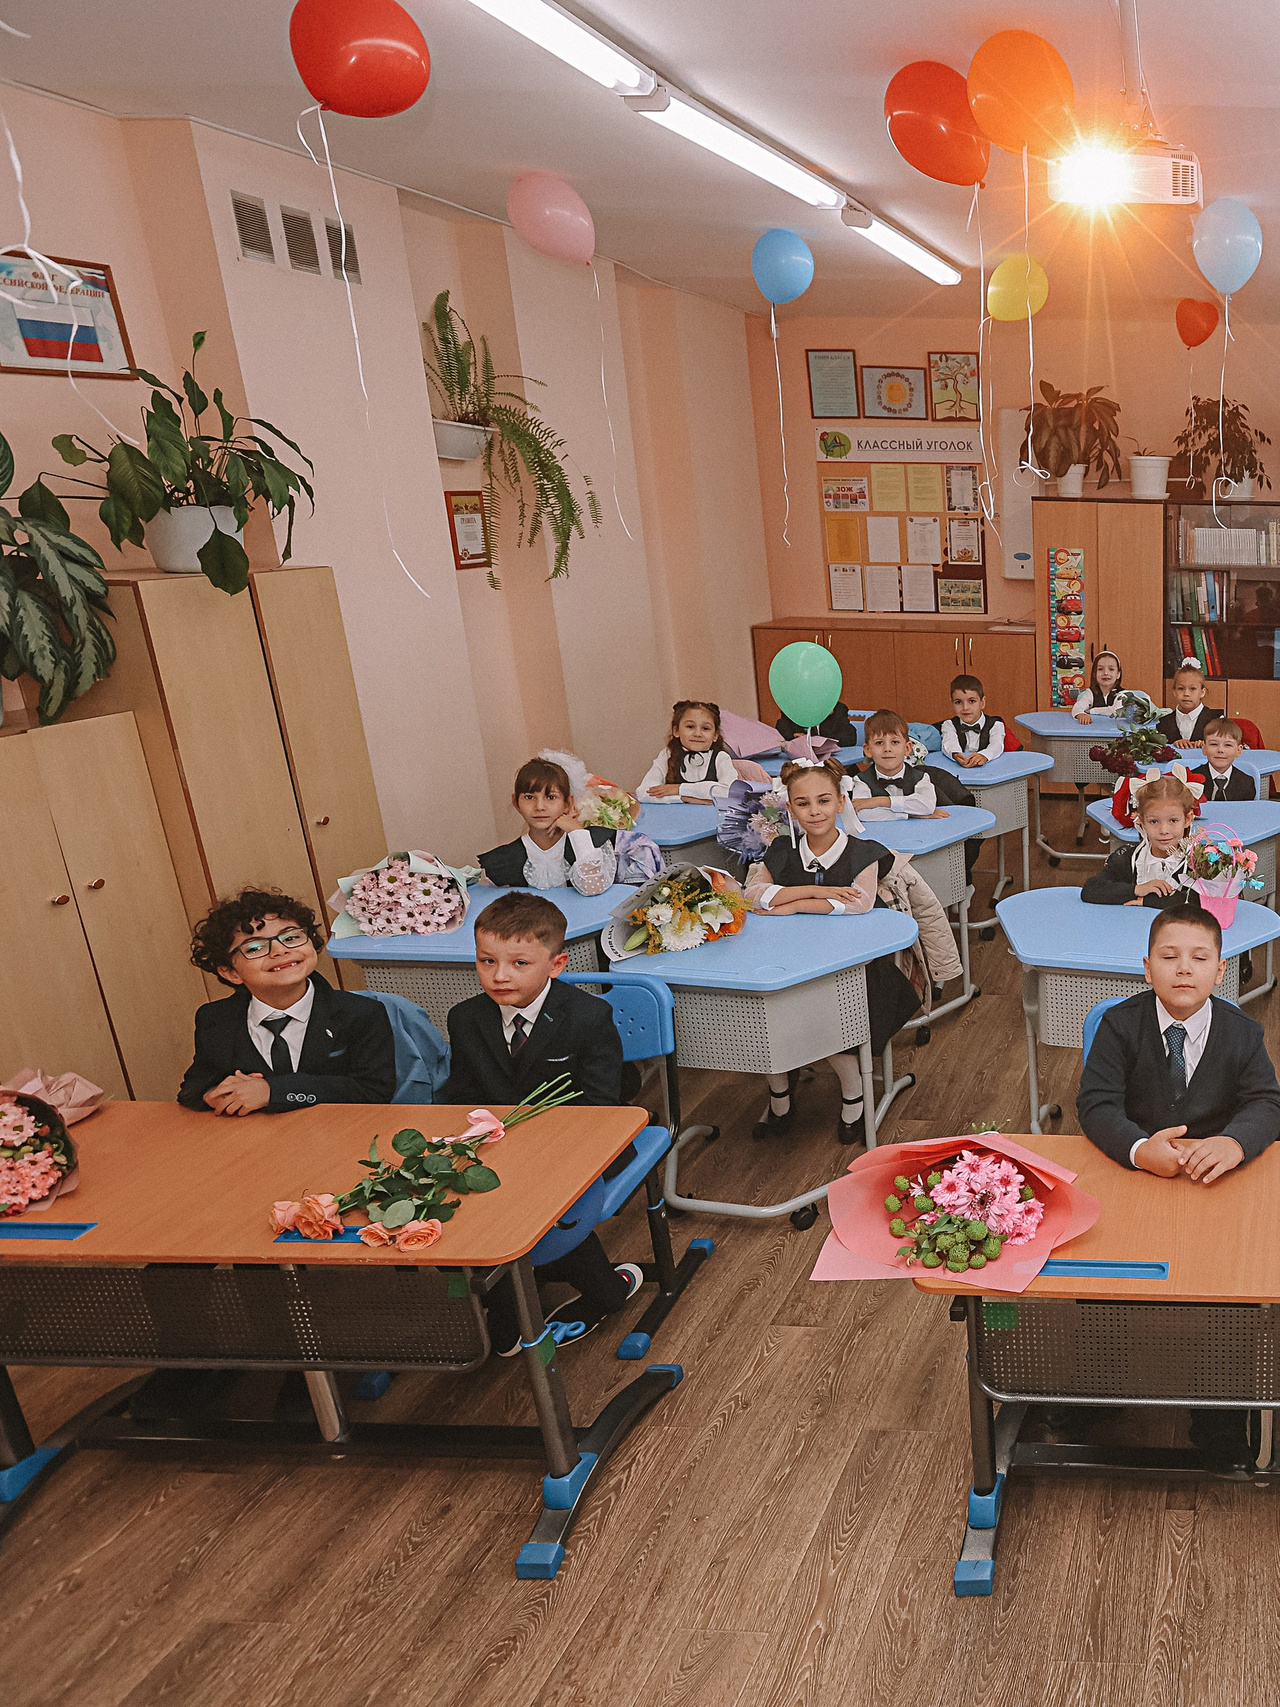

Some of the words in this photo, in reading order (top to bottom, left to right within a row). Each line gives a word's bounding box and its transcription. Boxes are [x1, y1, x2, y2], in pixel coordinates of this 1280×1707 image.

[31, 271, 57, 281] ФЛГ
[53, 284, 105, 298] ФЕЕРАЦИИ
[857, 438, 923, 450] КЛАССНЫЙ
[926, 440, 974, 451] УГОЛОК
